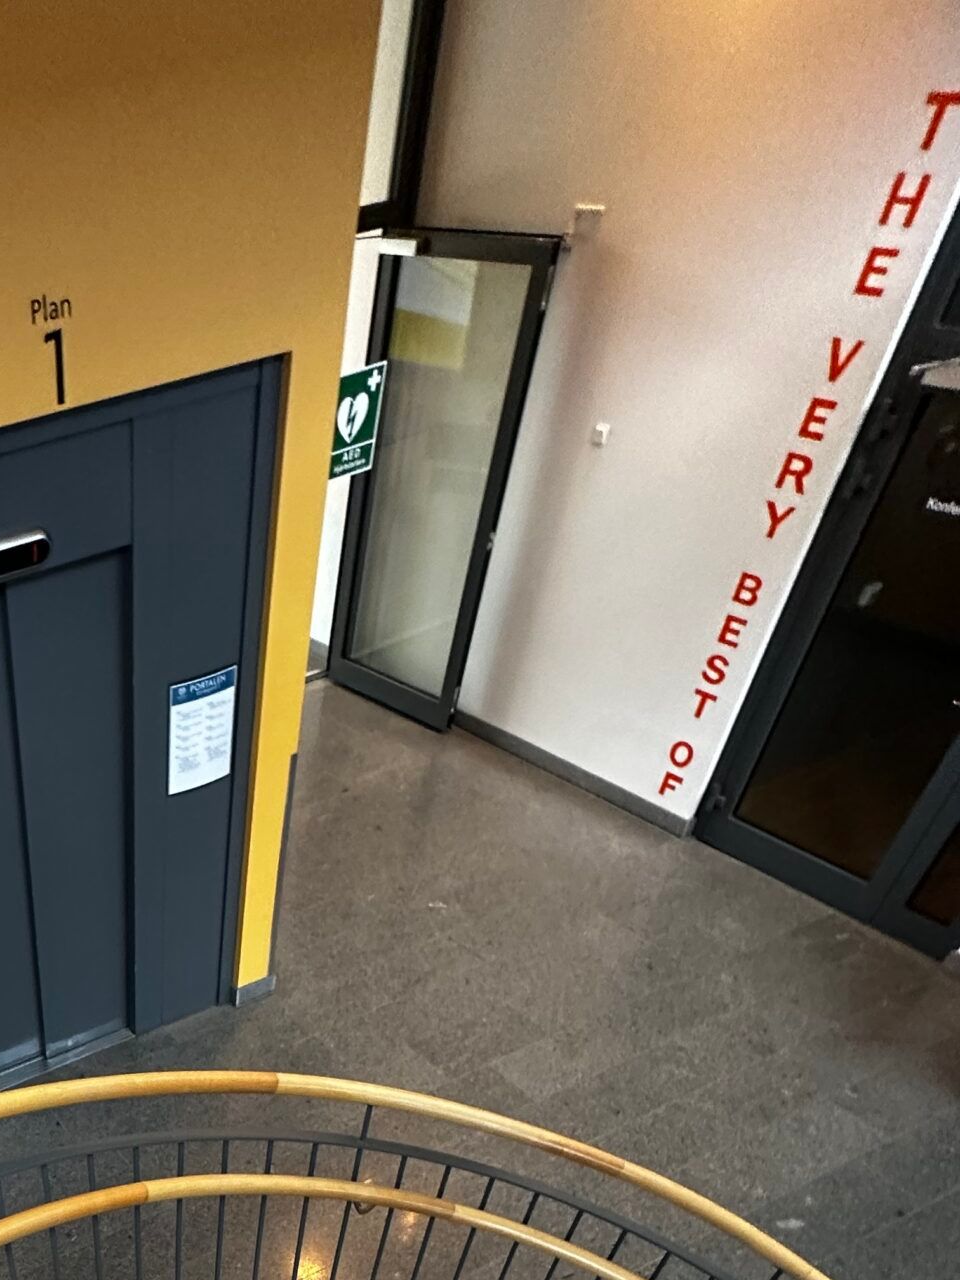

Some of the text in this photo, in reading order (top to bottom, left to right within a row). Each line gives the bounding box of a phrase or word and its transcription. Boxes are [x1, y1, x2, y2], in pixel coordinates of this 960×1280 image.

[30, 294, 72, 325] Plan
[44, 328, 65, 405] 1
[658, 89, 960, 795] THE VERY BEST OF
